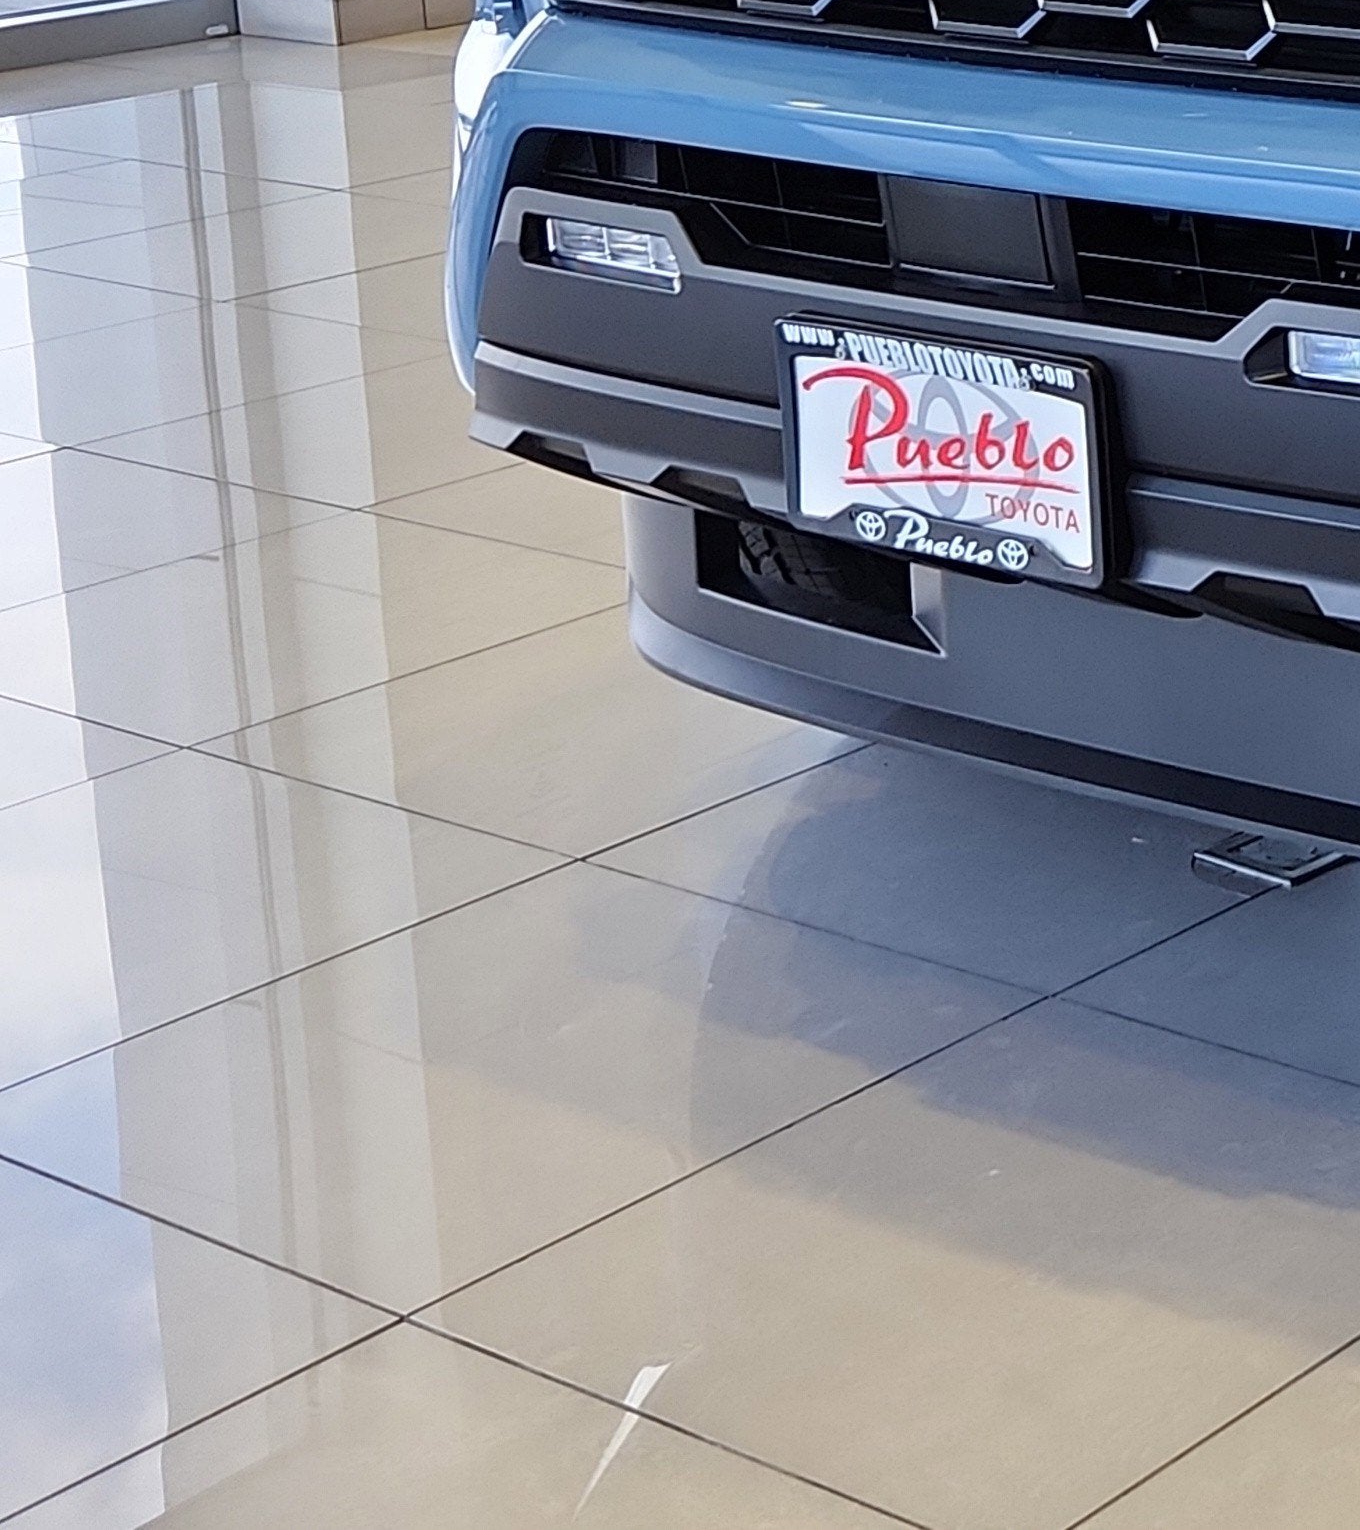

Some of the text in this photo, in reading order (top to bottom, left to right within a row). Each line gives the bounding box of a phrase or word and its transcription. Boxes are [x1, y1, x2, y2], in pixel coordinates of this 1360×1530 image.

[802, 366, 1075, 473] Pueblo
[883, 507, 995, 565] Pueblo
[985, 492, 1081, 534] TOYOTA
